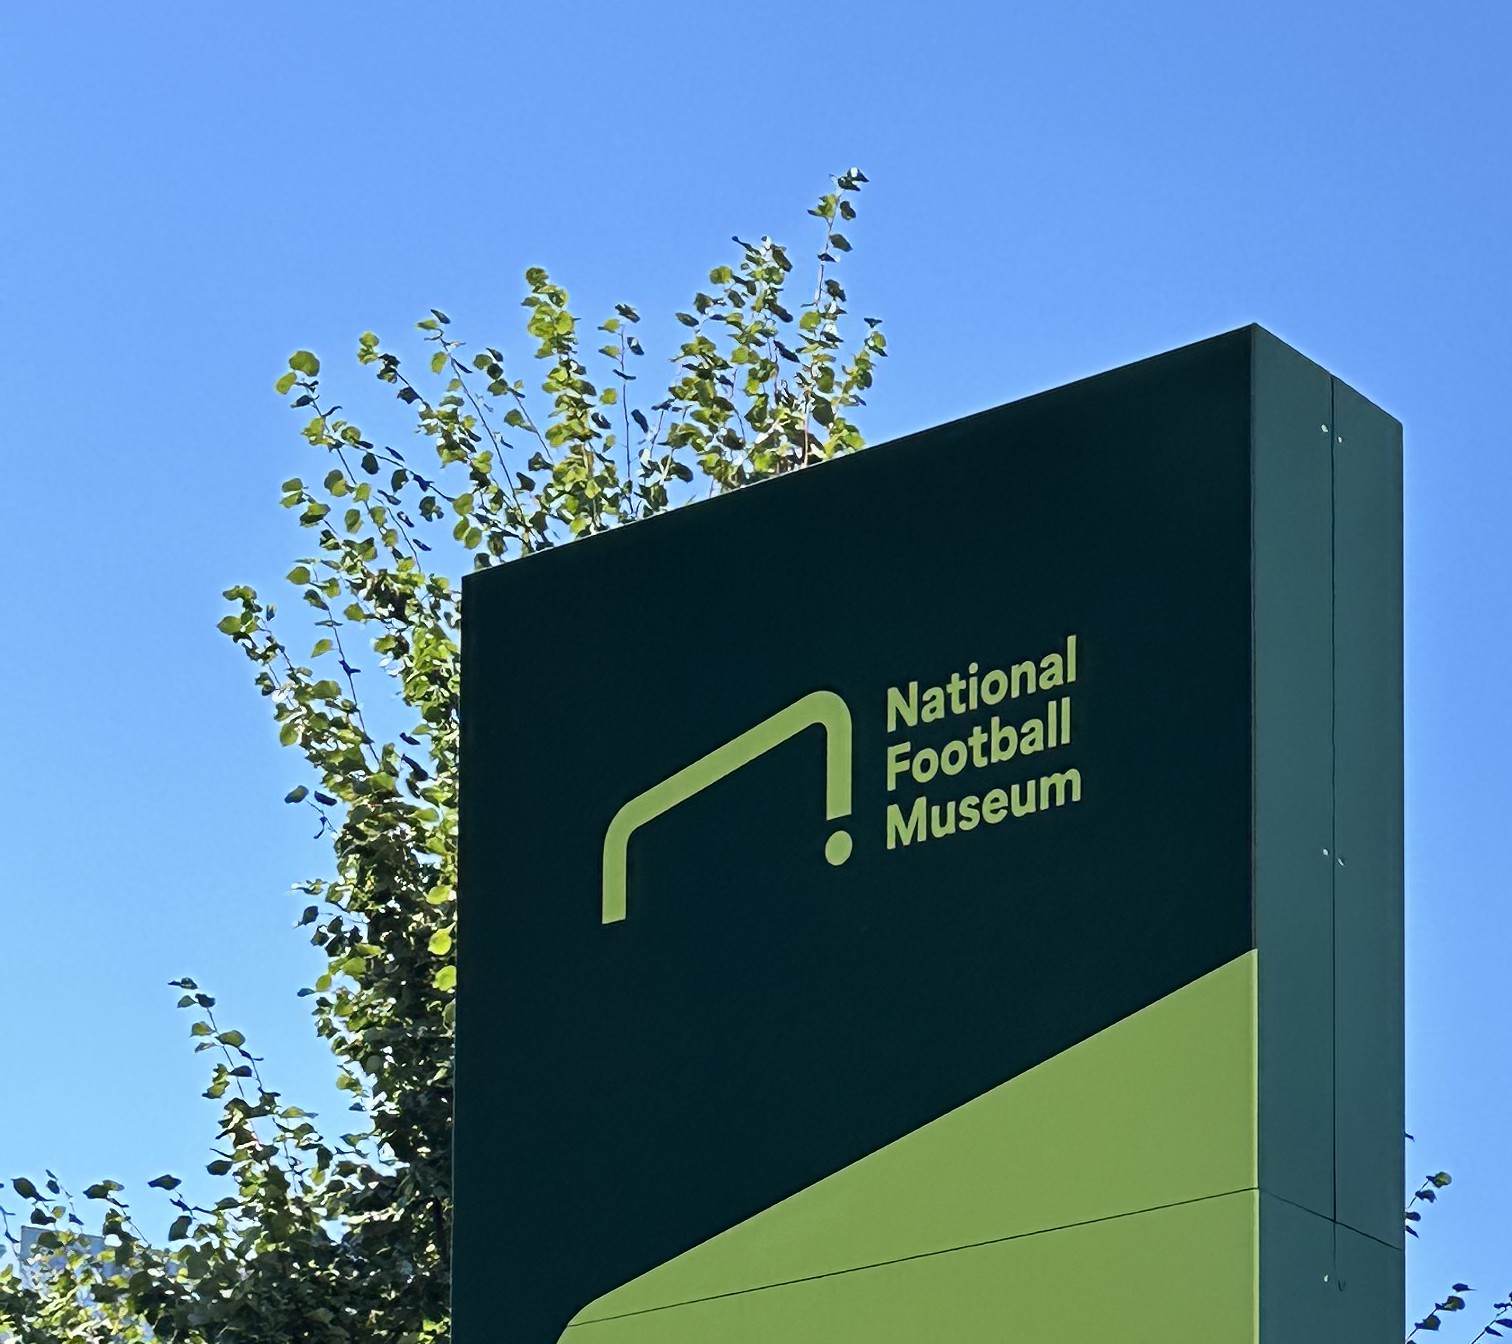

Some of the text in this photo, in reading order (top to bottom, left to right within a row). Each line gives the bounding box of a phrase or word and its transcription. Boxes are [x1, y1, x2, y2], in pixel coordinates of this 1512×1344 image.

[886, 634, 1077, 733] National
[886, 696, 1071, 792] Football
[886, 769, 1082, 850] Museum
